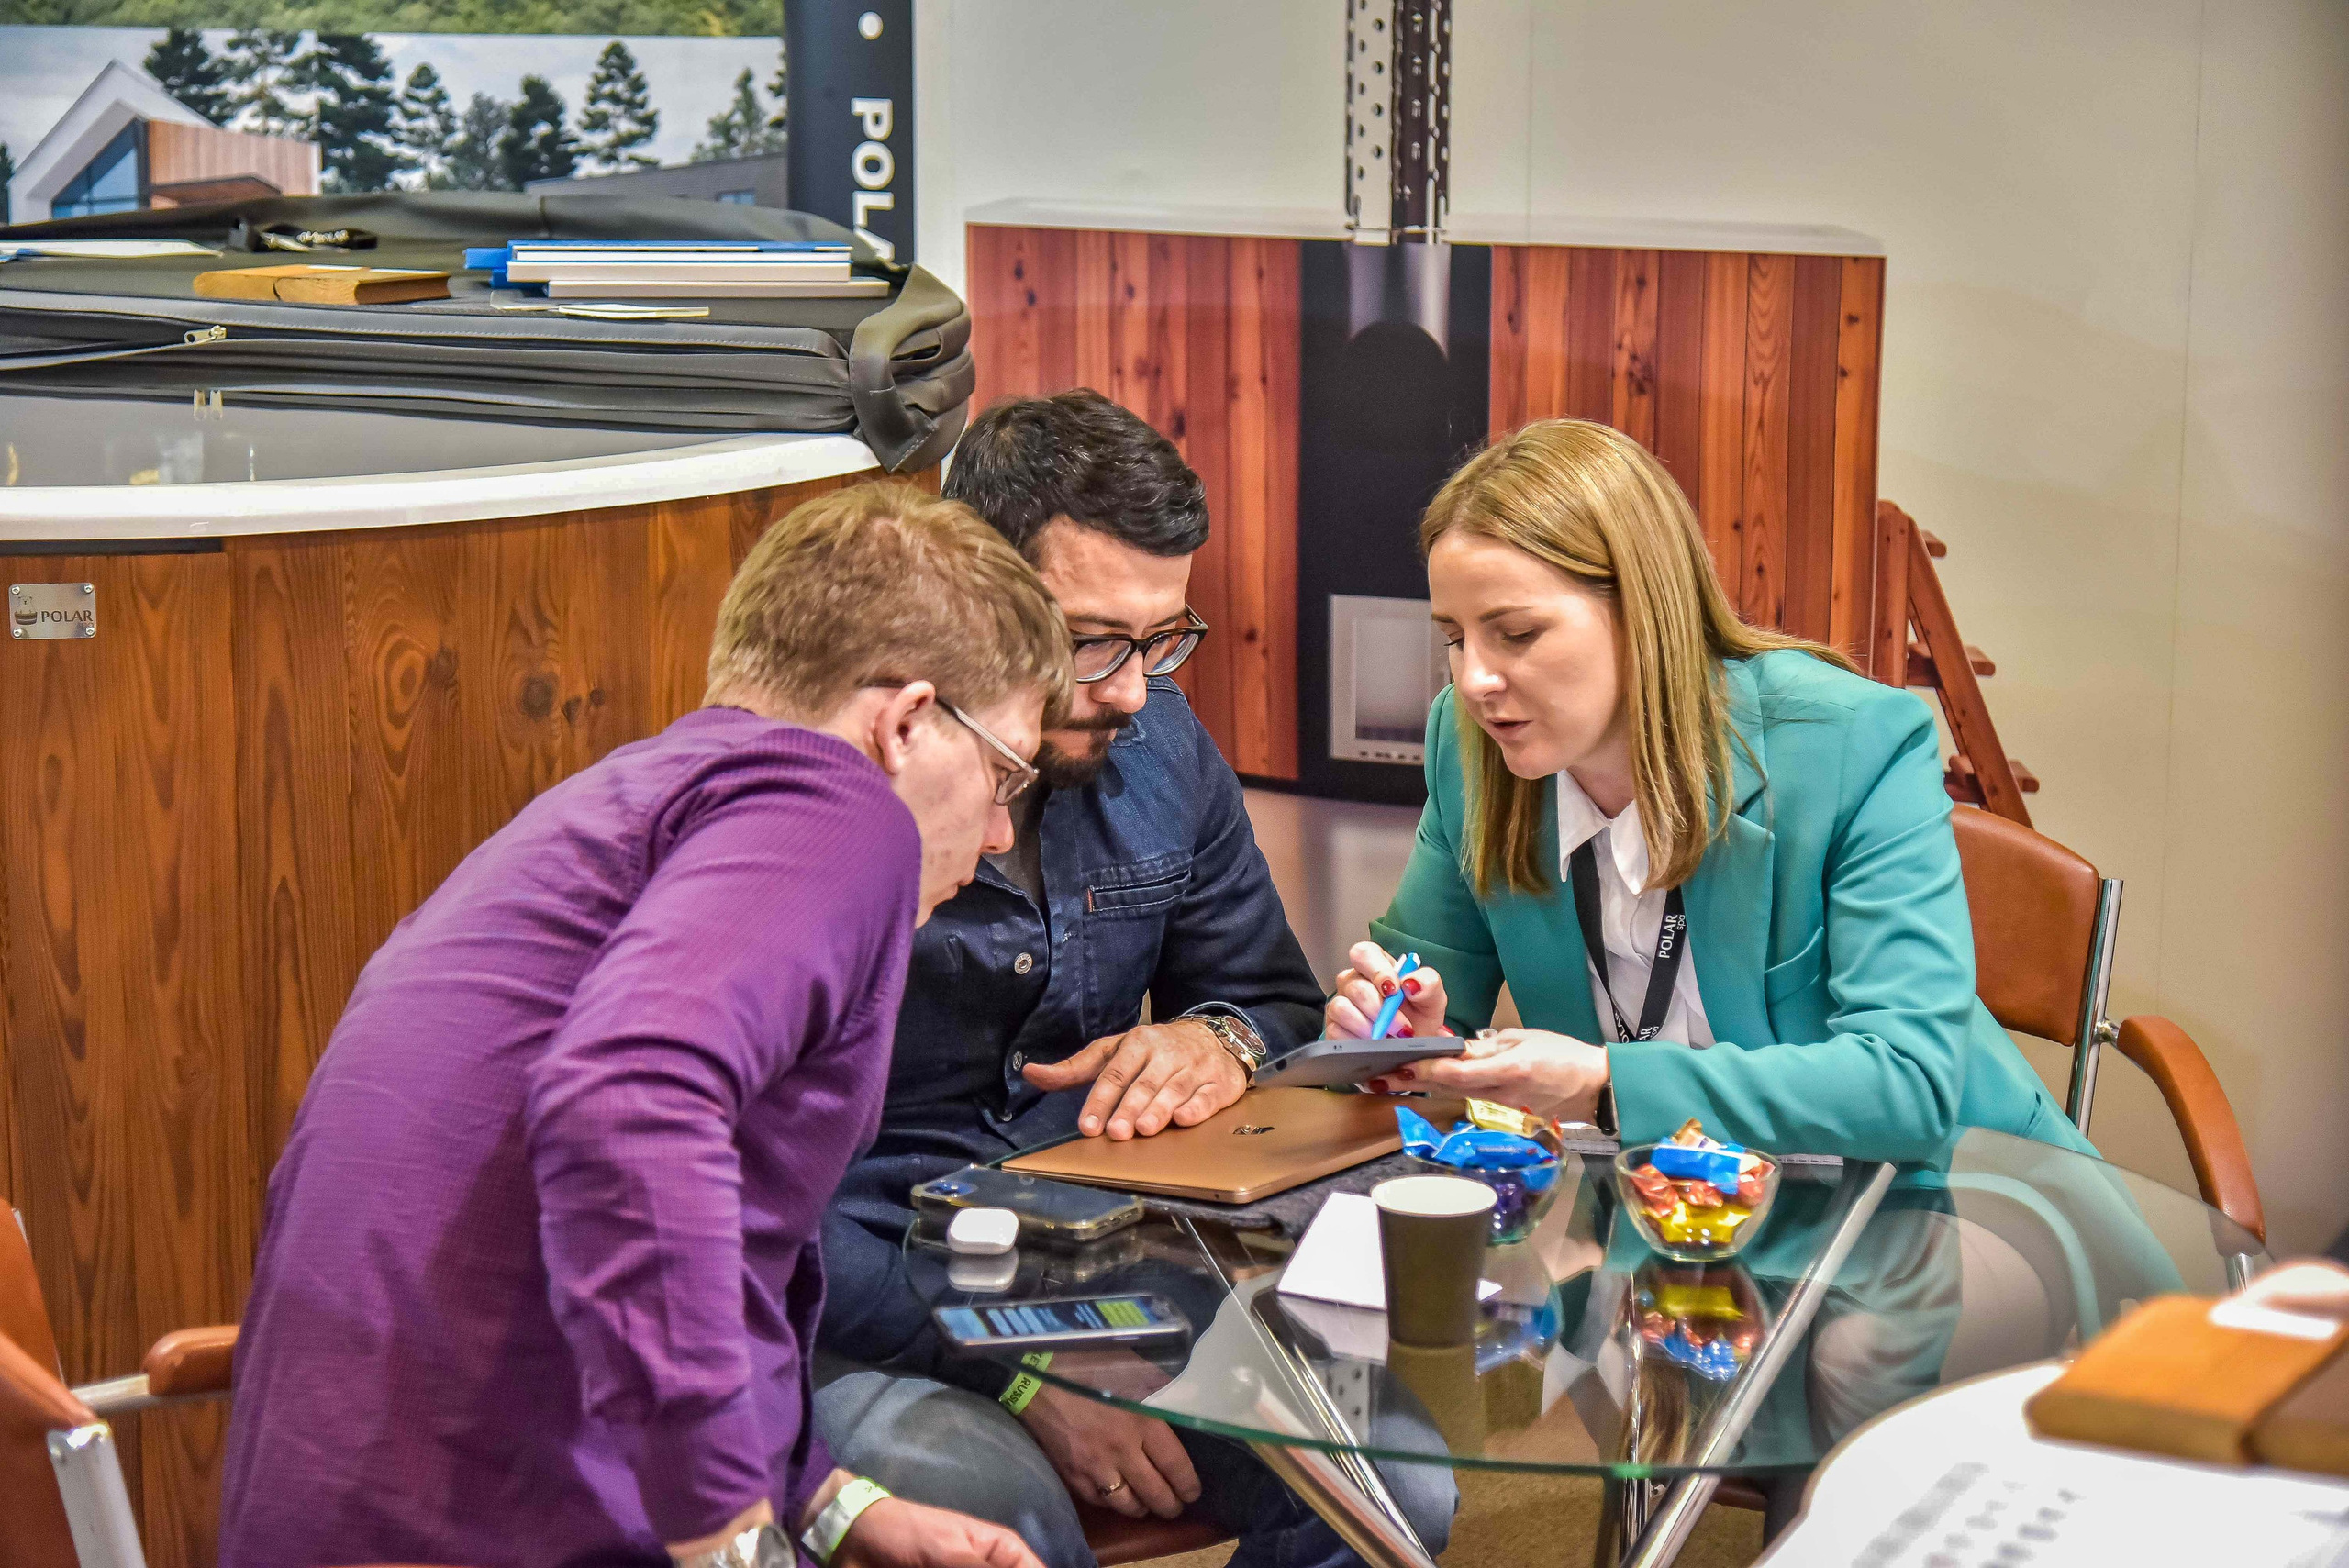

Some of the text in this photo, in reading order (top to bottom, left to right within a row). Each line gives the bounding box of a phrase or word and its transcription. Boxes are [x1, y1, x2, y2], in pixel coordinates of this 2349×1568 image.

[40, 609, 94, 623] POLAR
[1676, 914, 1687, 930] spa
[1658, 914, 1678, 959] POLAR
